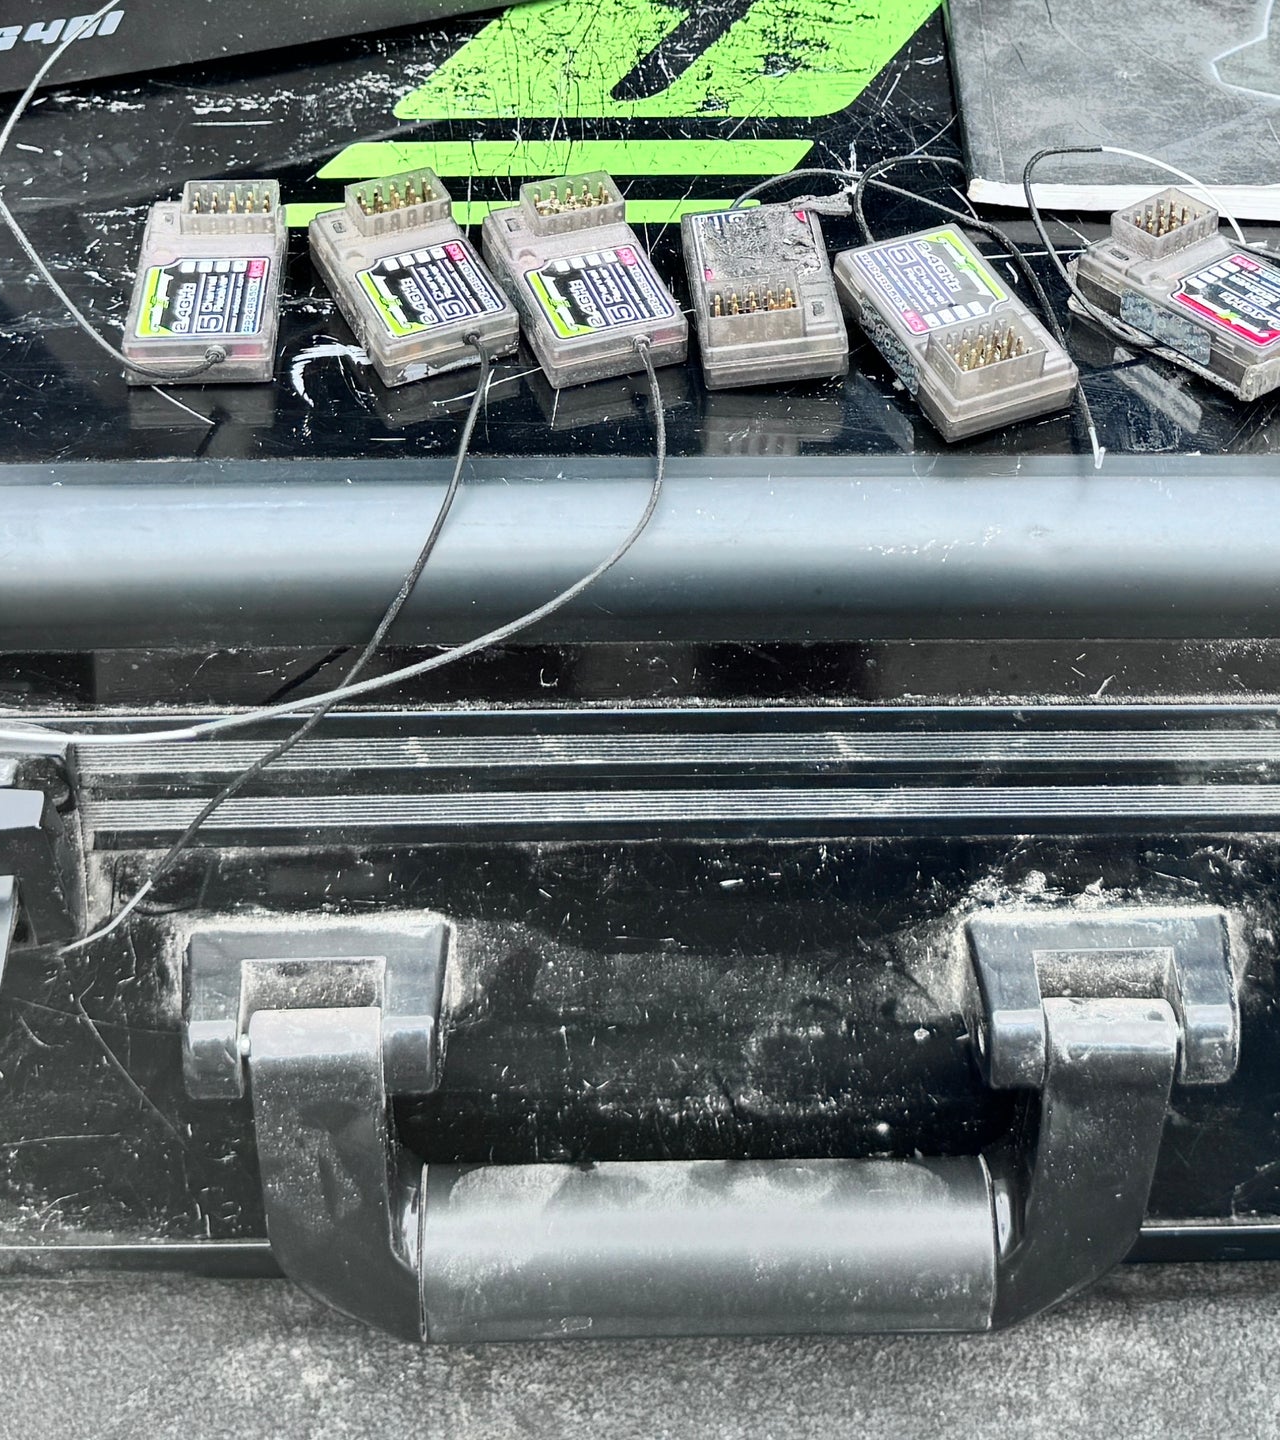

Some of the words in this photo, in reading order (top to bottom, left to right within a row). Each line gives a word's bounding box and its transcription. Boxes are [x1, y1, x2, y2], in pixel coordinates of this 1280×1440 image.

[888, 246, 916, 265] 5
[438, 300, 468, 319] 5
[607, 304, 635, 323] 5
[198, 315, 223, 332] 5
